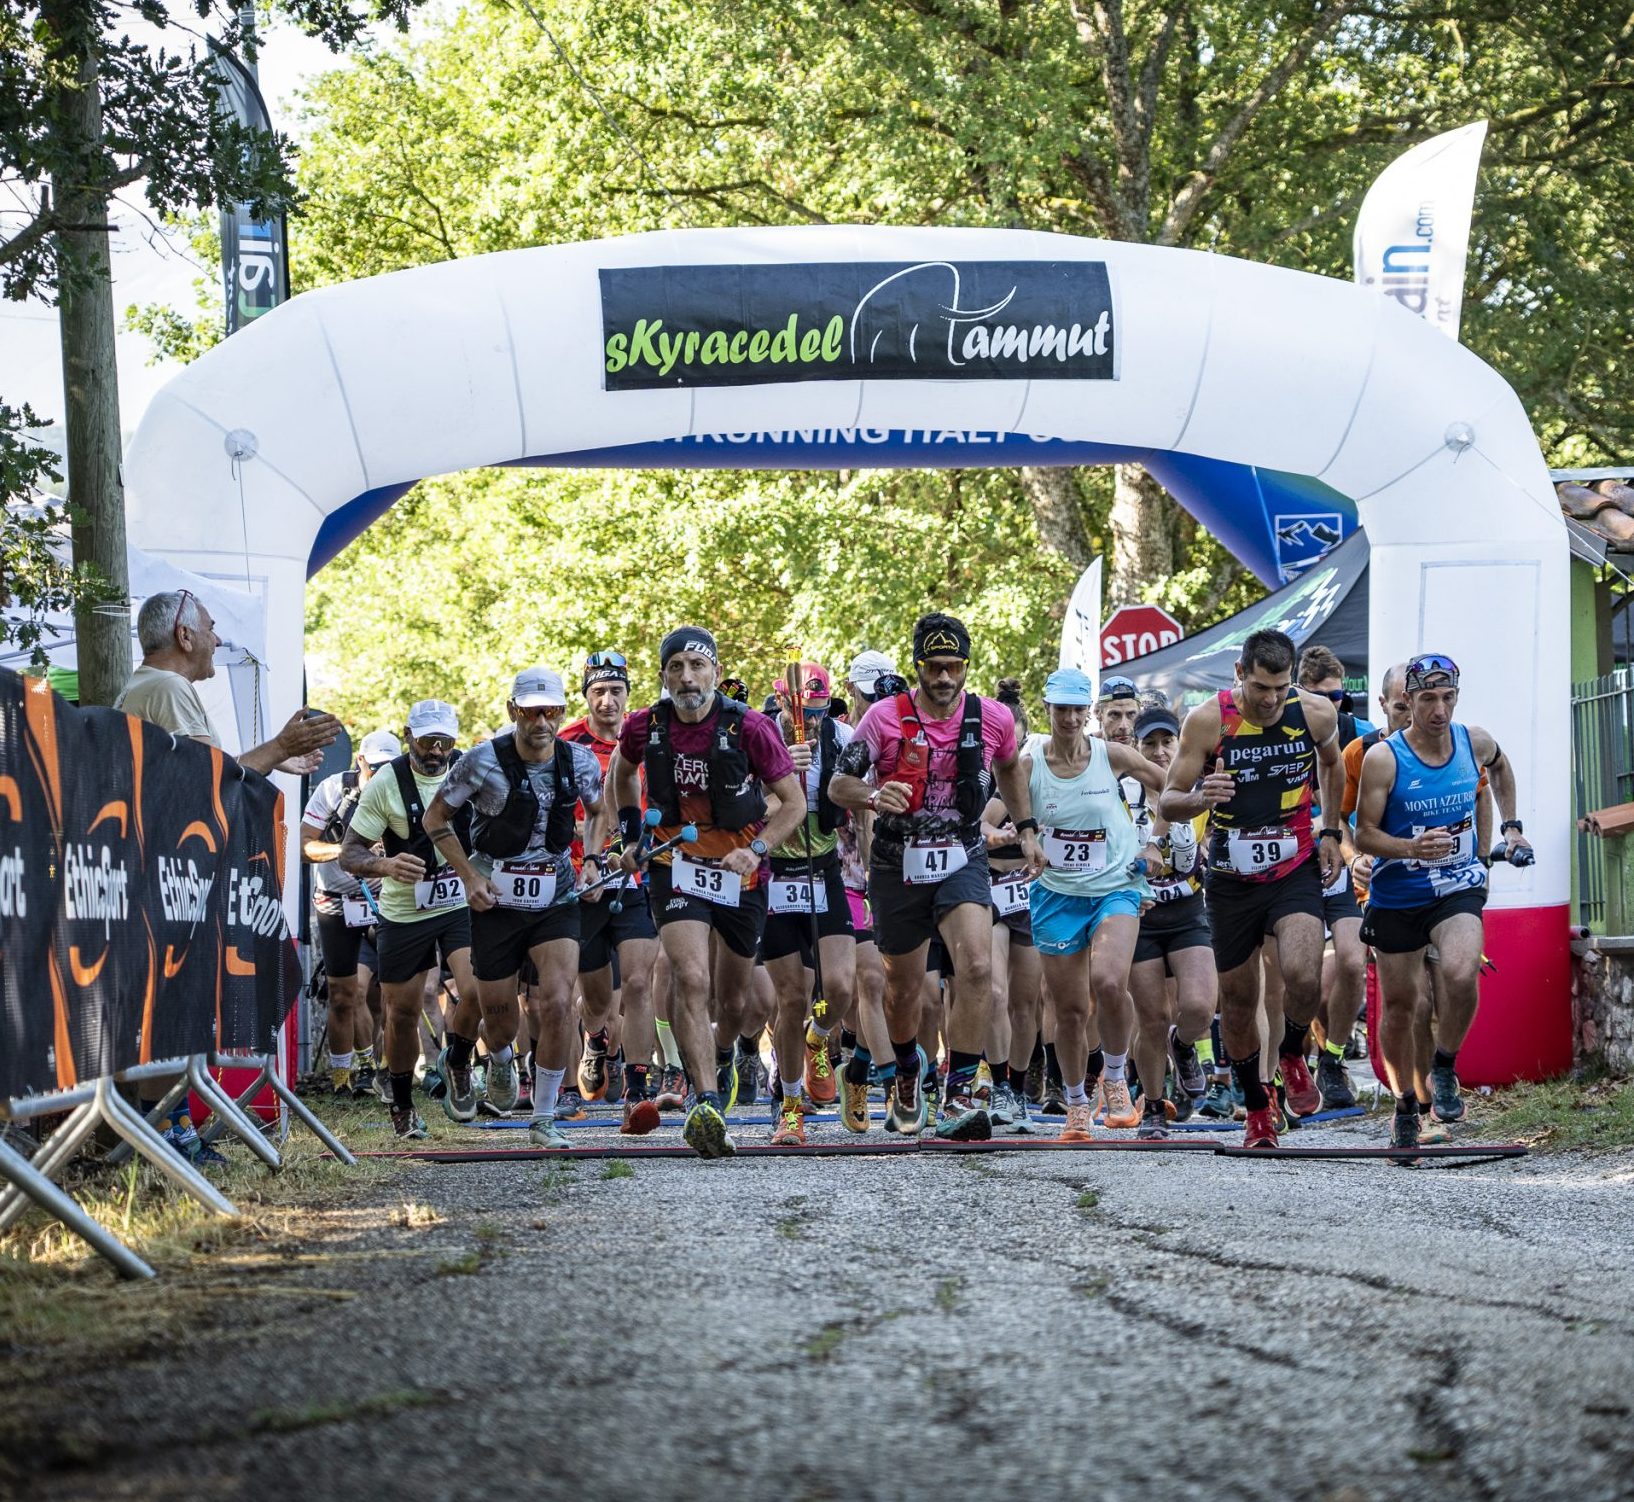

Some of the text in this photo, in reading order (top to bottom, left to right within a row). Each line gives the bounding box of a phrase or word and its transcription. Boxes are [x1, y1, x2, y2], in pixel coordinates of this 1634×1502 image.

[1230, 740, 1306, 766] pegarun
[1404, 797, 1438, 812] MONTI
[1442, 805, 1462, 814] TEAM
[1063, 843, 1090, 862] 23
[1251, 841, 1281, 864] 39
[1450, 836, 1461, 855] 9
[925, 849, 948, 872] 47
[0, 846, 27, 918] ort
[436, 879, 461, 900] 92
[513, 877, 541, 898] 80
[694, 867, 723, 892] 53
[785, 884, 811, 903] 34
[1004, 882, 1029, 904] 75
